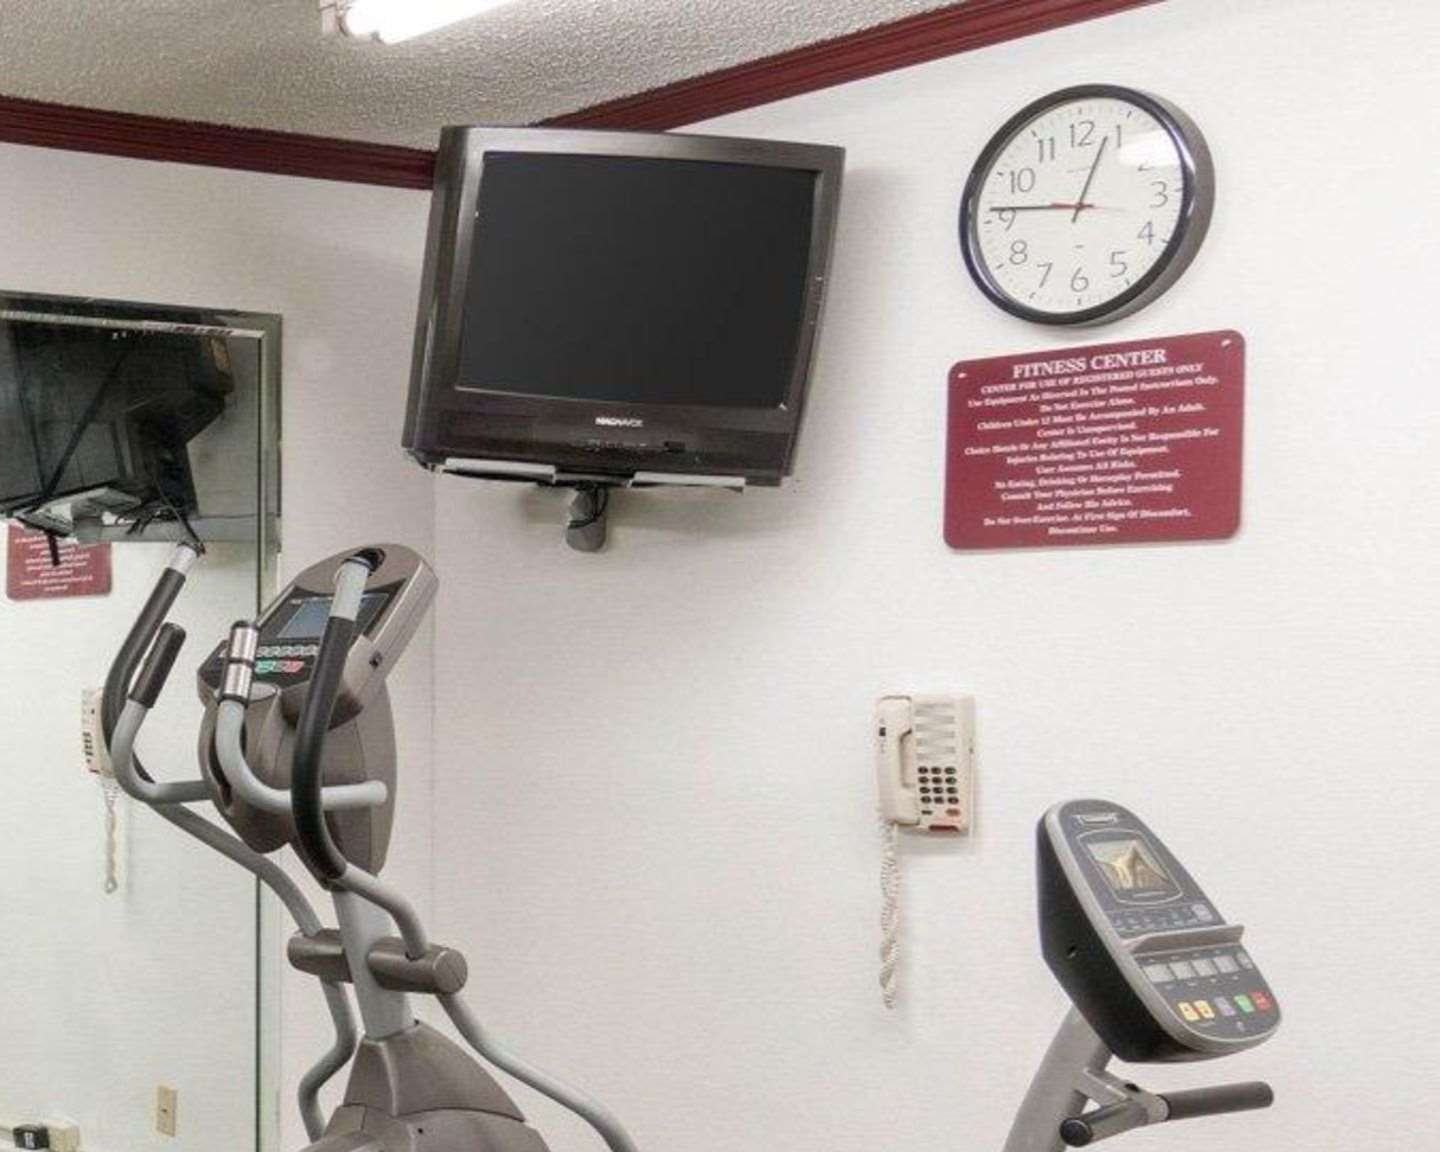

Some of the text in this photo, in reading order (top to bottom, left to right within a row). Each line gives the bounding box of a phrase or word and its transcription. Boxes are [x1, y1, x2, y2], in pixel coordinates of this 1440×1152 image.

[1070, 121, 1095, 148] 12
[1038, 137, 1055, 162] 11
[1010, 168, 1036, 194] 10
[1150, 181, 1168, 208] 3
[998, 208, 1017, 231] 9
[1137, 221, 1156, 245] 4
[1010, 240, 1028, 265] 8
[1110, 251, 1127, 277] 5
[1037, 262, 1053, 288] 7
[1071, 267, 1089, 292] 6
[1013, 348, 1166, 379] FITNESS CENTER
[981, 383, 1016, 394] CENTER
[1073, 371, 1134, 384] REGISTERED
[1135, 366, 1174, 378] GUESTS
[1175, 363, 1203, 374] ONLY
[984, 396, 1027, 407] Equipment
